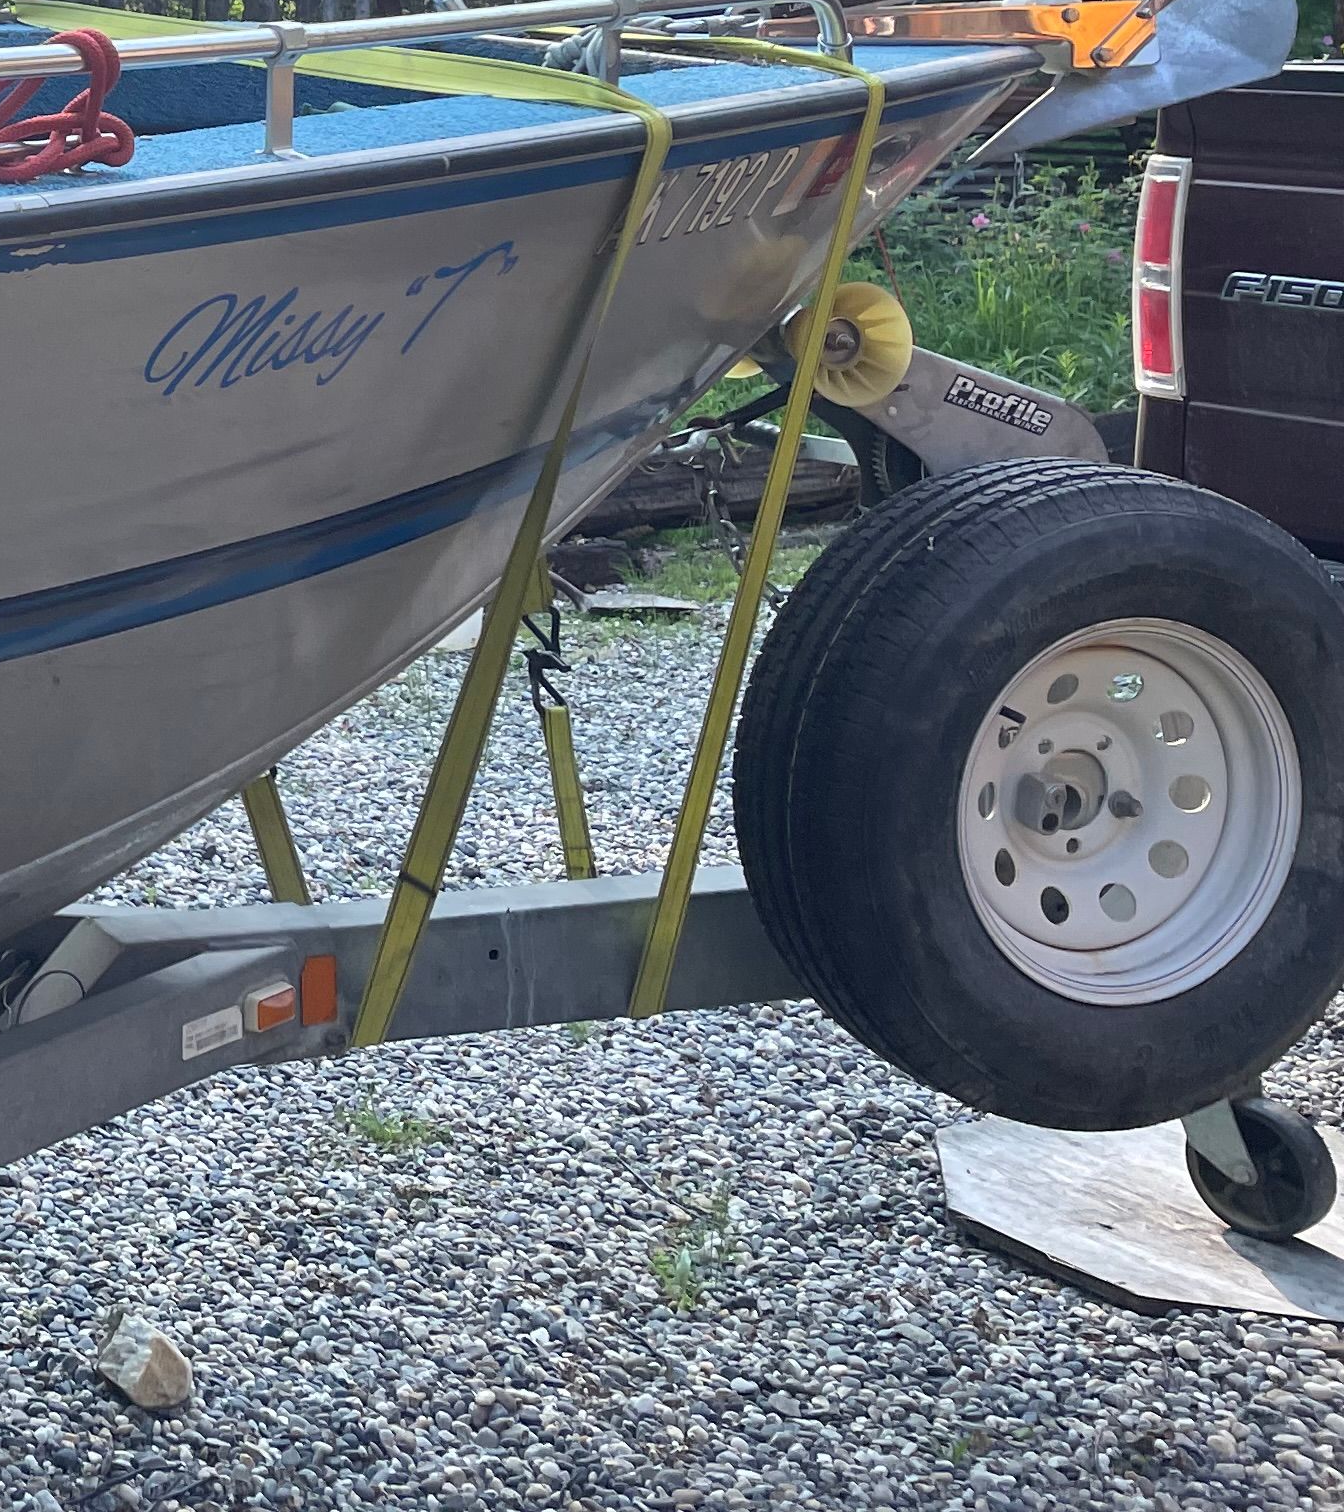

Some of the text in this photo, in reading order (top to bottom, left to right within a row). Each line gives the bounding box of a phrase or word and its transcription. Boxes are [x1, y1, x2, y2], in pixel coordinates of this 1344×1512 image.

[660, 151, 771, 241] 7192
[744, 145, 801, 220] P
[144, 286, 386, 396] Missy
[946, 394, 1045, 435] PERFORMANCE WINCH
[948, 375, 1053, 429] Profile
